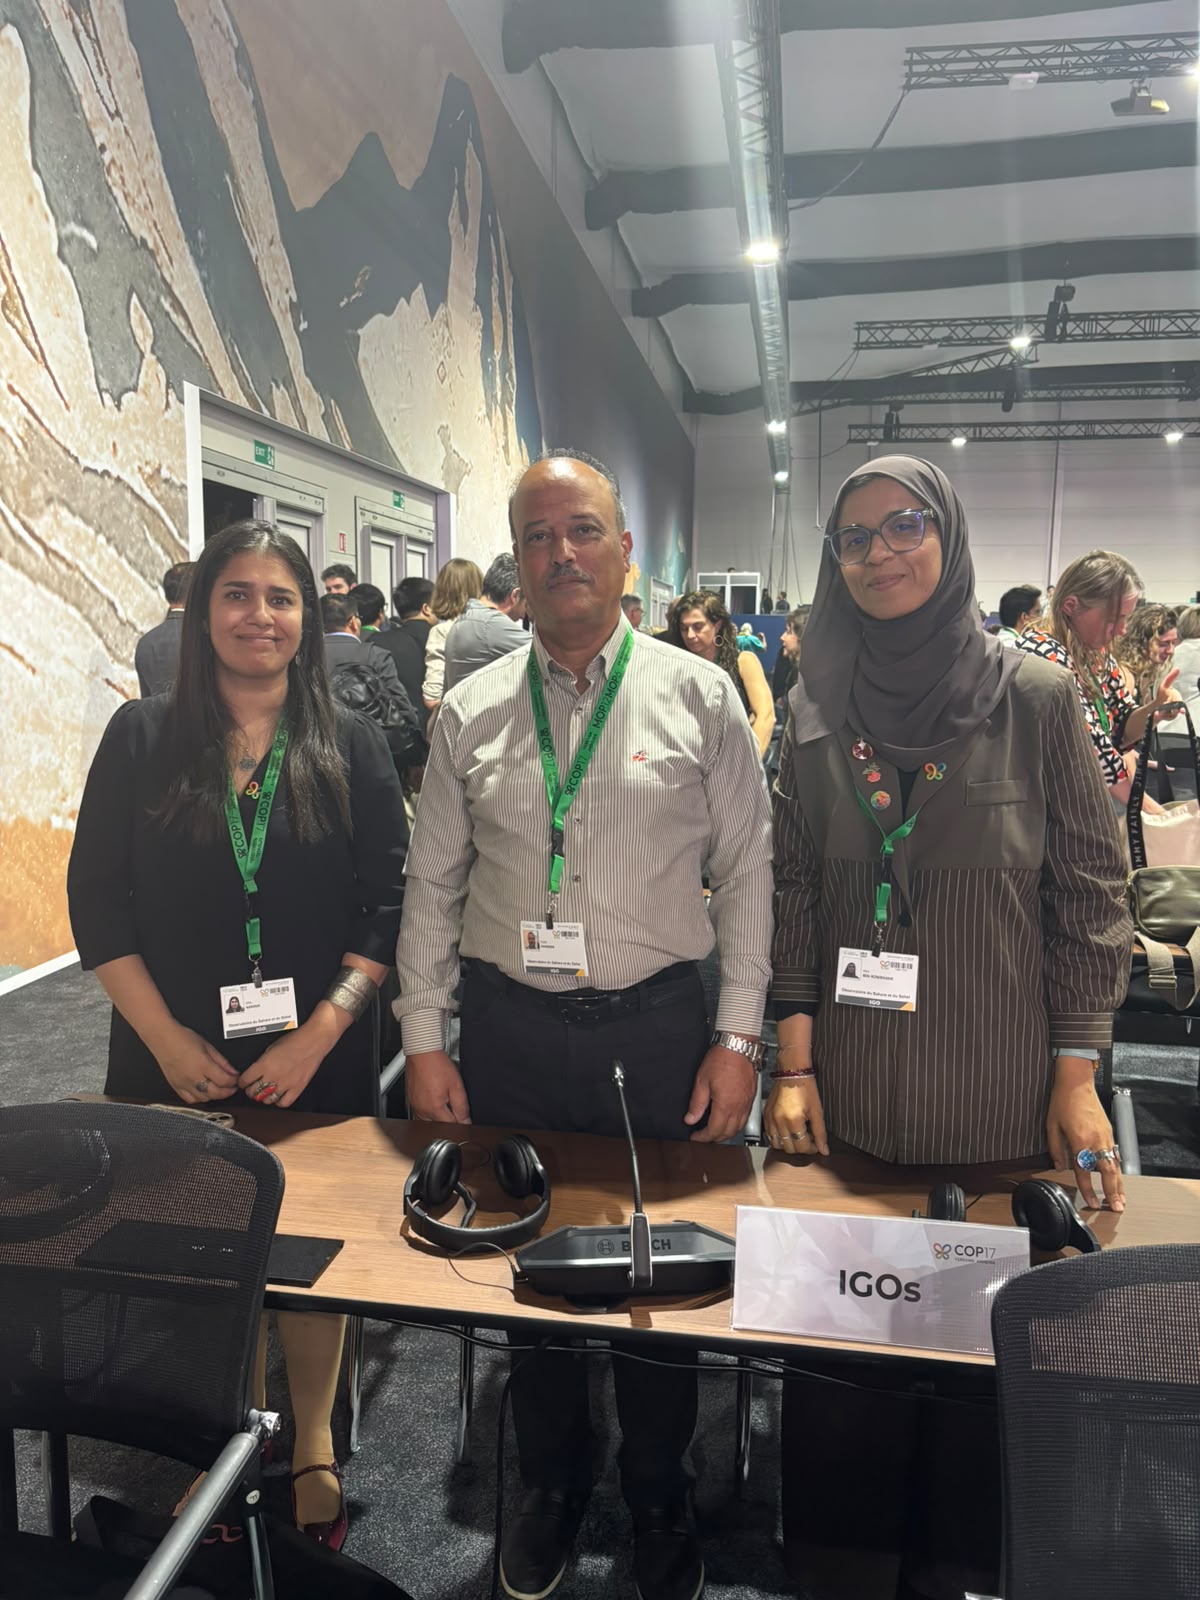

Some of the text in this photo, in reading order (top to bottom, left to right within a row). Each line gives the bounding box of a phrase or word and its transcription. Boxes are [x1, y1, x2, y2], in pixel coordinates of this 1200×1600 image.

[542, 738, 555, 767] COP17
[568, 755, 588, 787] COP17
[256, 801, 270, 832] COP17
[621, 1238, 672, 1252] BCH
[954, 1244, 997, 1259] COP17
[839, 1269, 922, 1303] IGOs
